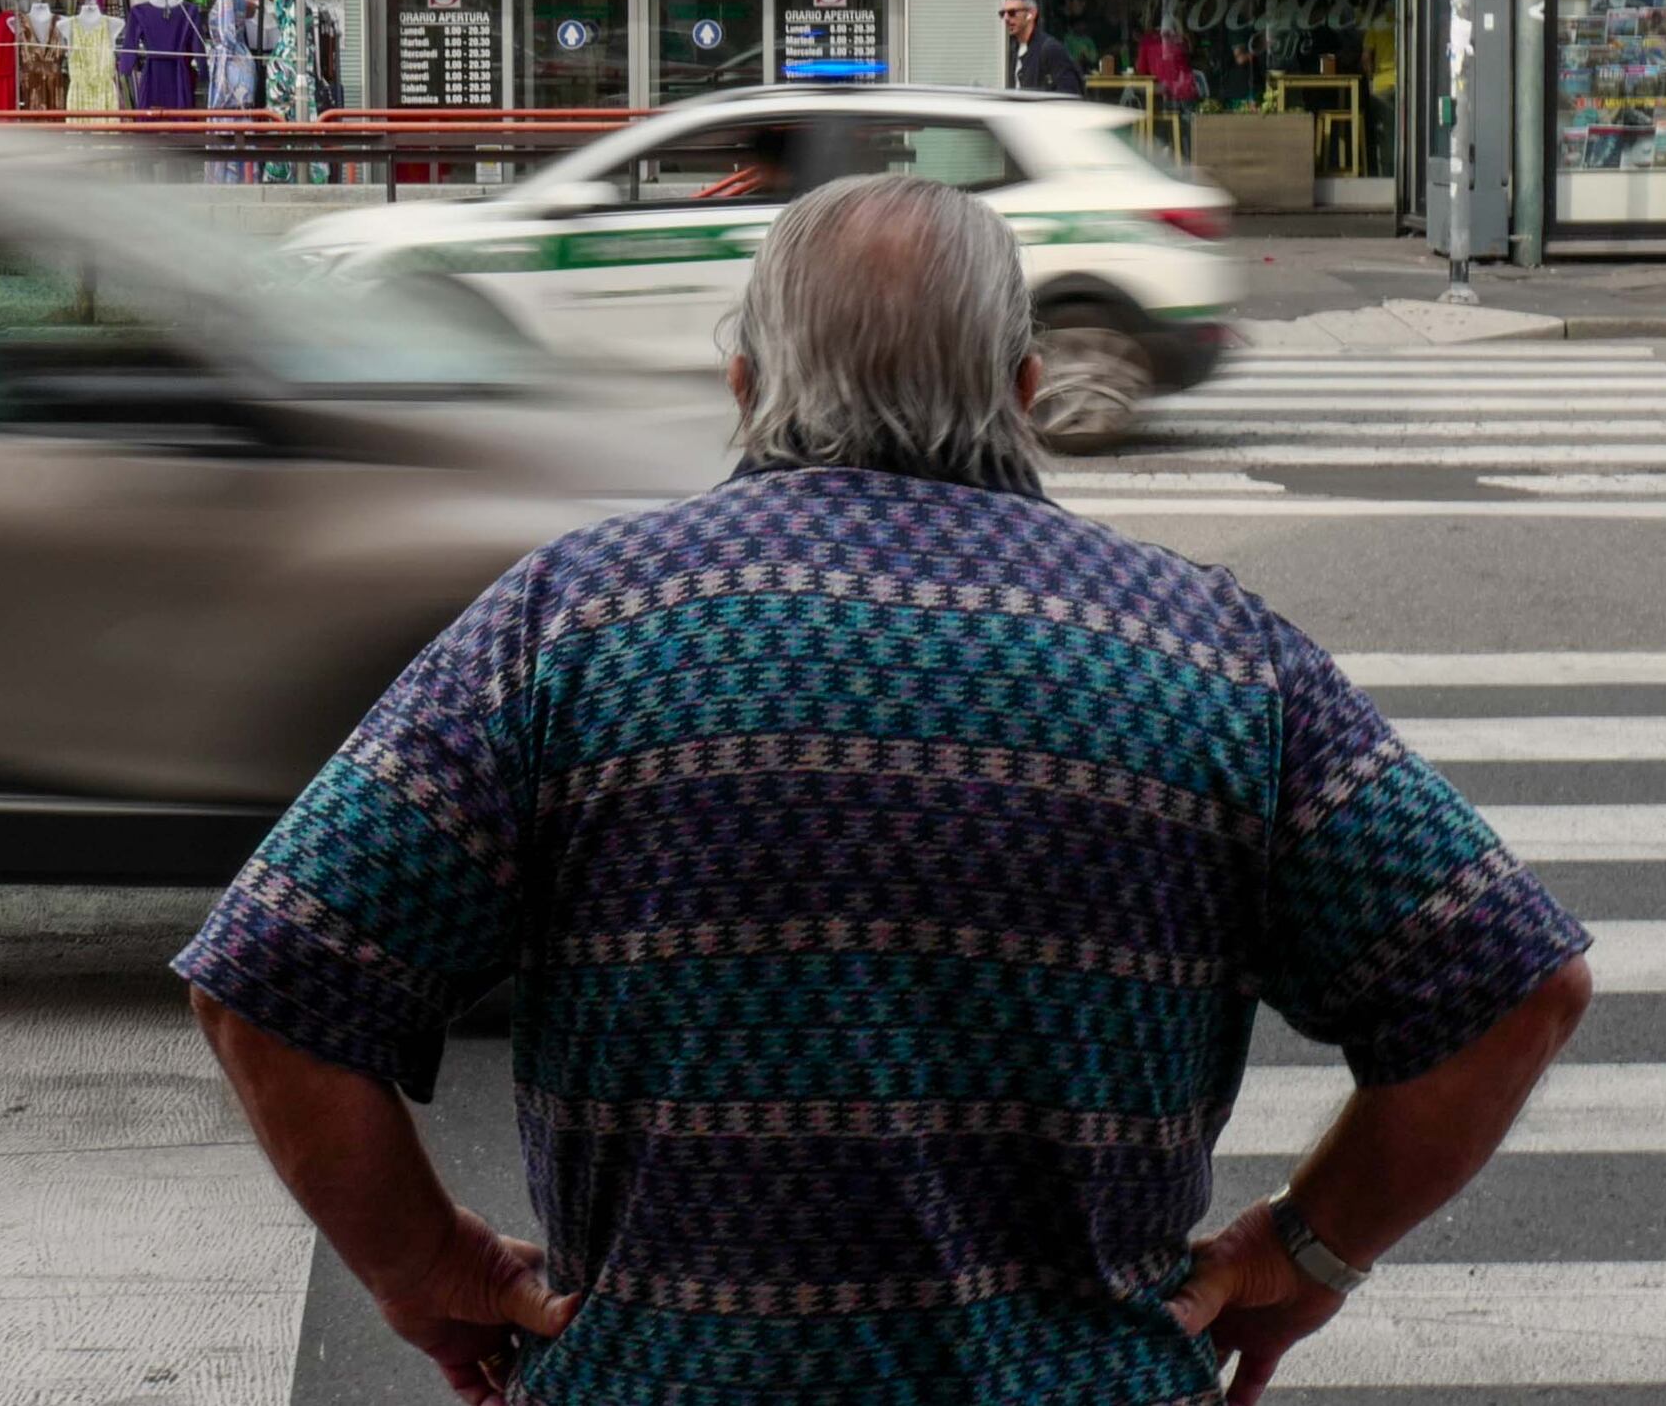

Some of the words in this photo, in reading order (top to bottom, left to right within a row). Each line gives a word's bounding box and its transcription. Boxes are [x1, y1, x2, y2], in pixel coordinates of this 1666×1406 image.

[399, 12, 436, 23] ORARIO
[438, 12, 490, 23] APERTURA
[785, 10, 822, 21] ORARIO
[824, 10, 875, 21] APERTURA
